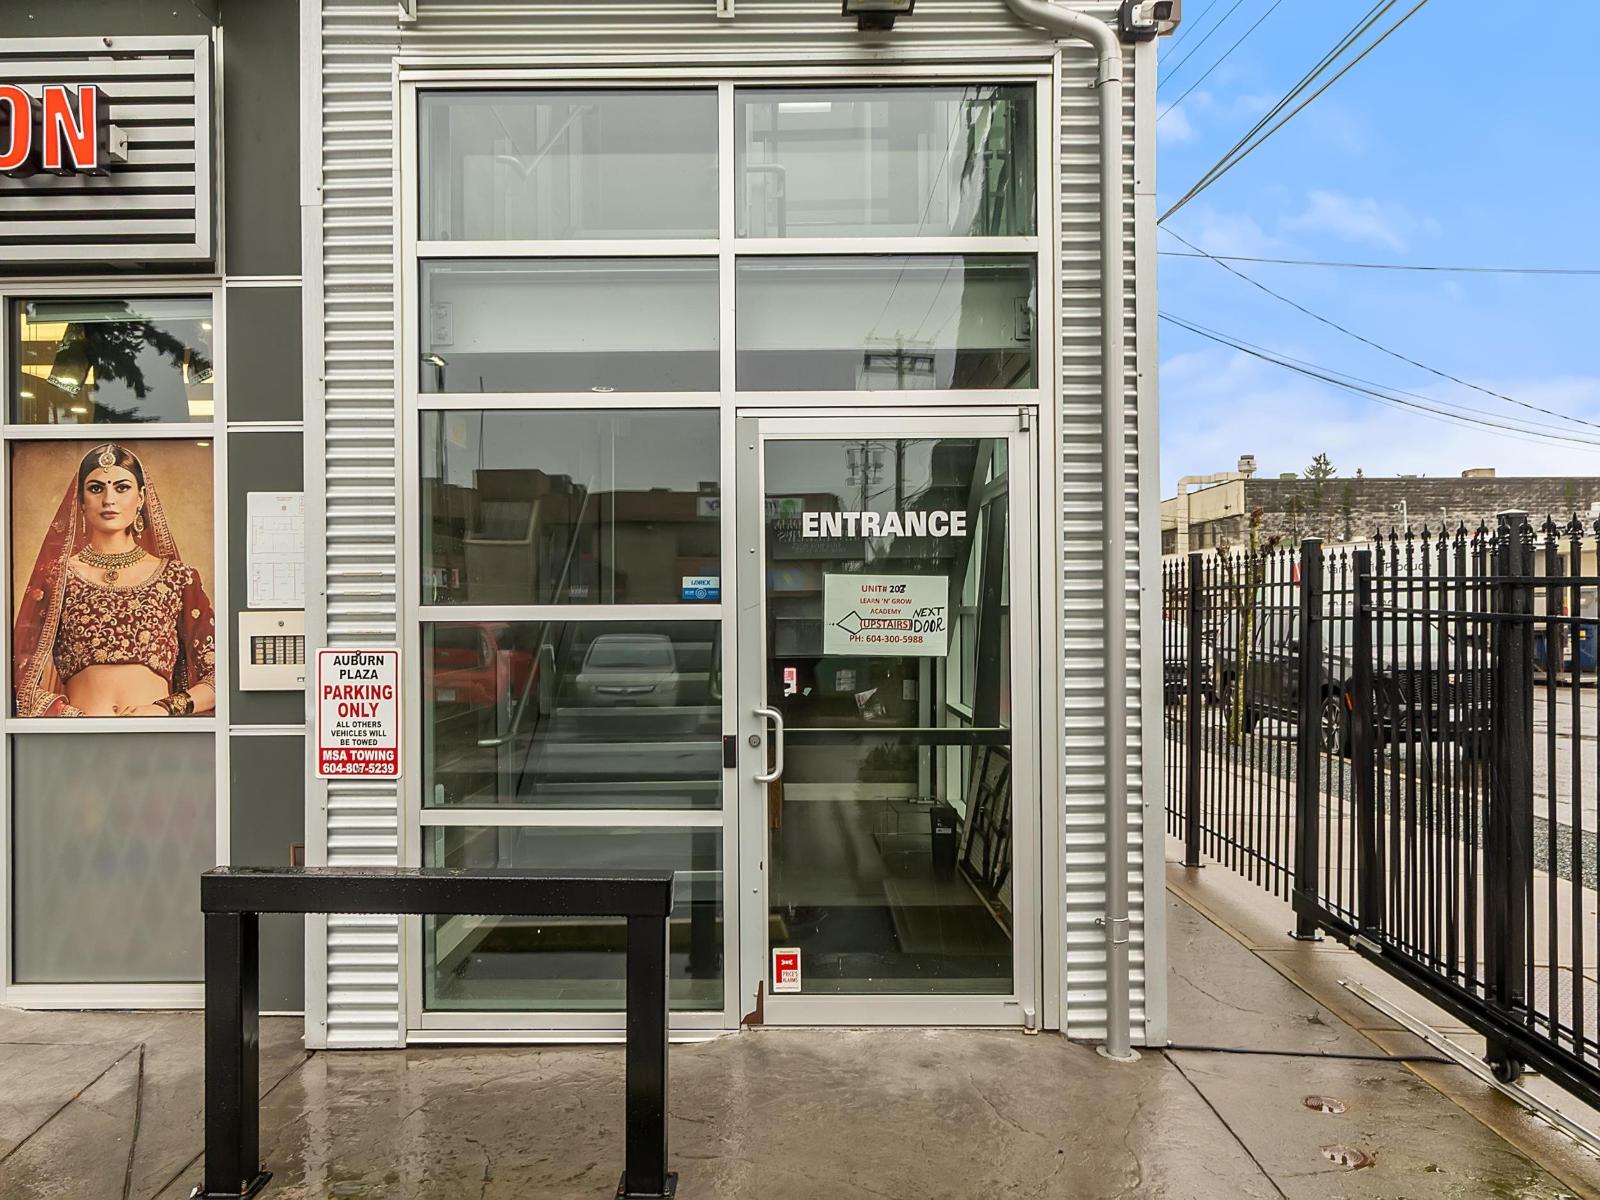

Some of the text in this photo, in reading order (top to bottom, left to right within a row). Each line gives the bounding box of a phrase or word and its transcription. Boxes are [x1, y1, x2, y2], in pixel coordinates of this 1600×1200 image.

[802, 510, 967, 538] ENTRANCE
[861, 584, 888, 593] UNIT#
[912, 606, 944, 618] NEXT
[914, 617, 946, 632] DOOR
[850, 634, 924, 644] PH: 604-300-5988
[333, 655, 384, 666] AUBURN
[340, 669, 378, 680] PLAZA
[324, 684, 393, 700] PARKING
[338, 702, 380, 718] ONLY
[323, 750, 394, 760] MSA TOWING
[323, 762, 394, 774] 604-807-5239
